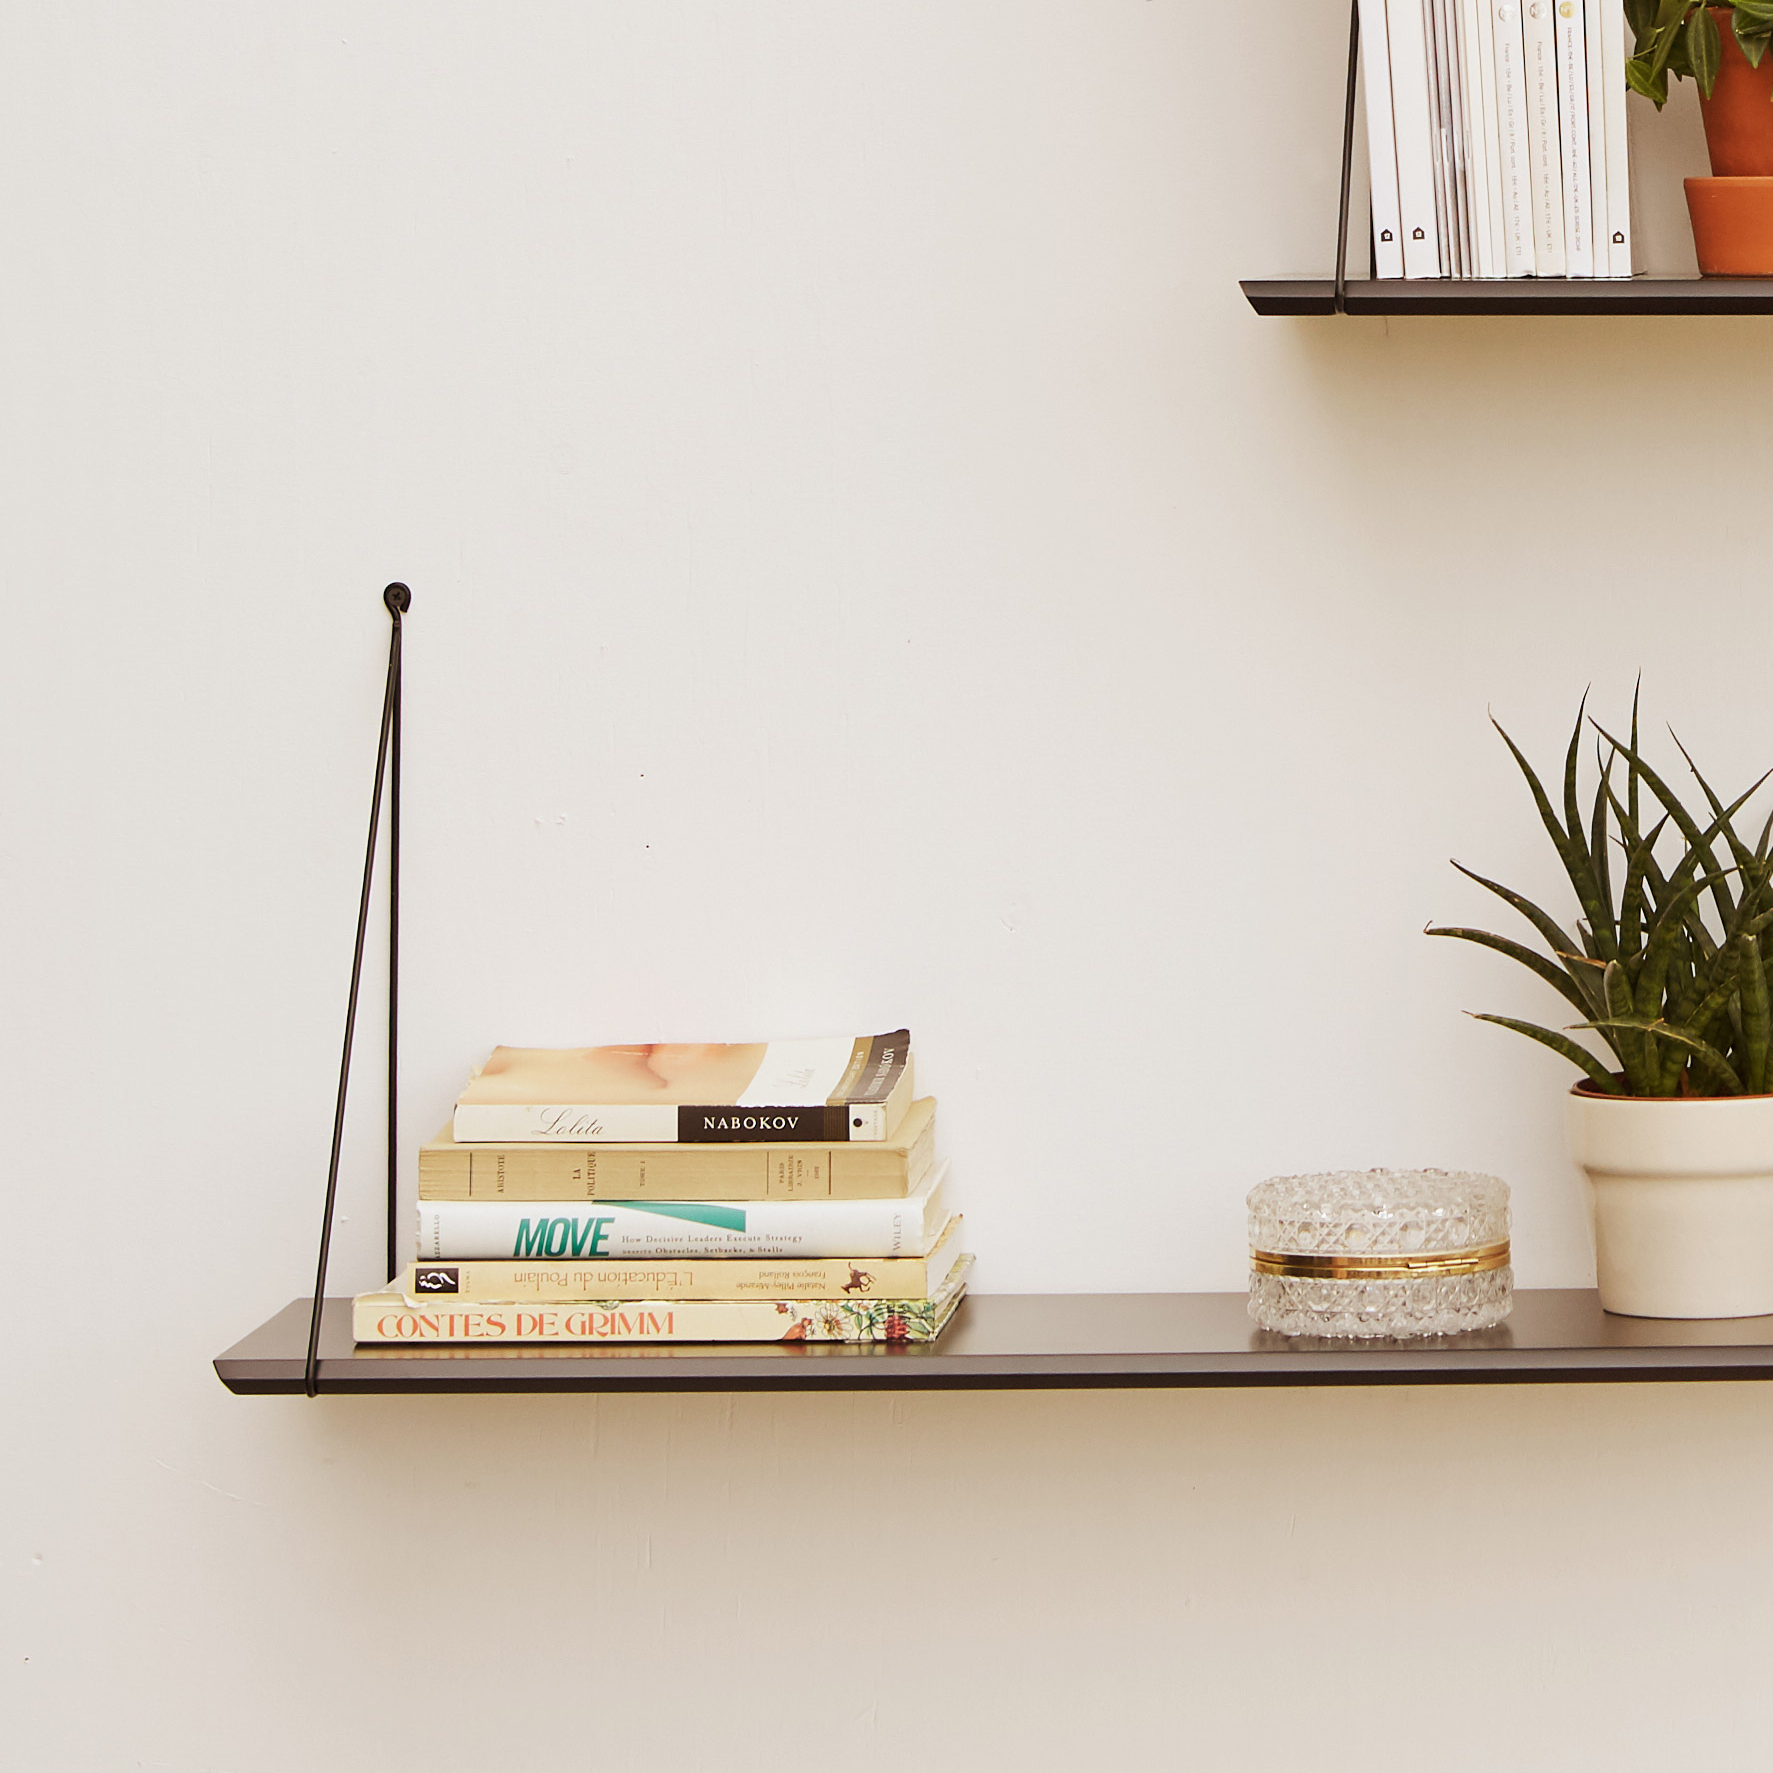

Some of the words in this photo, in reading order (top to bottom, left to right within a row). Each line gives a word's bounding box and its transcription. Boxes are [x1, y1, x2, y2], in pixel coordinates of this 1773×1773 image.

[531, 1108, 605, 1137] Lolita
[703, 1116, 800, 1130] NABOKOV
[572, 1169, 580, 1180] LA
[586, 1152, 596, 1196] POLITIQUE
[514, 1218, 615, 1257] MOVE
[622, 1235, 641, 1243] How
[646, 1235, 684, 1243] Decisive
[688, 1234, 722, 1243] Leaders
[726, 1234, 762, 1242] Execute
[766, 1234, 802, 1244] Strategy
[892, 1213, 901, 1250] WILEY
[514, 1272, 568, 1292] Poulain
[574, 1272, 594, 1292] du
[598, 1272, 694, 1292] L'Éducation
[377, 1313, 506, 1338] CONTES
[516, 1312, 559, 1336] DE
[565, 1312, 674, 1338] GRIMM
